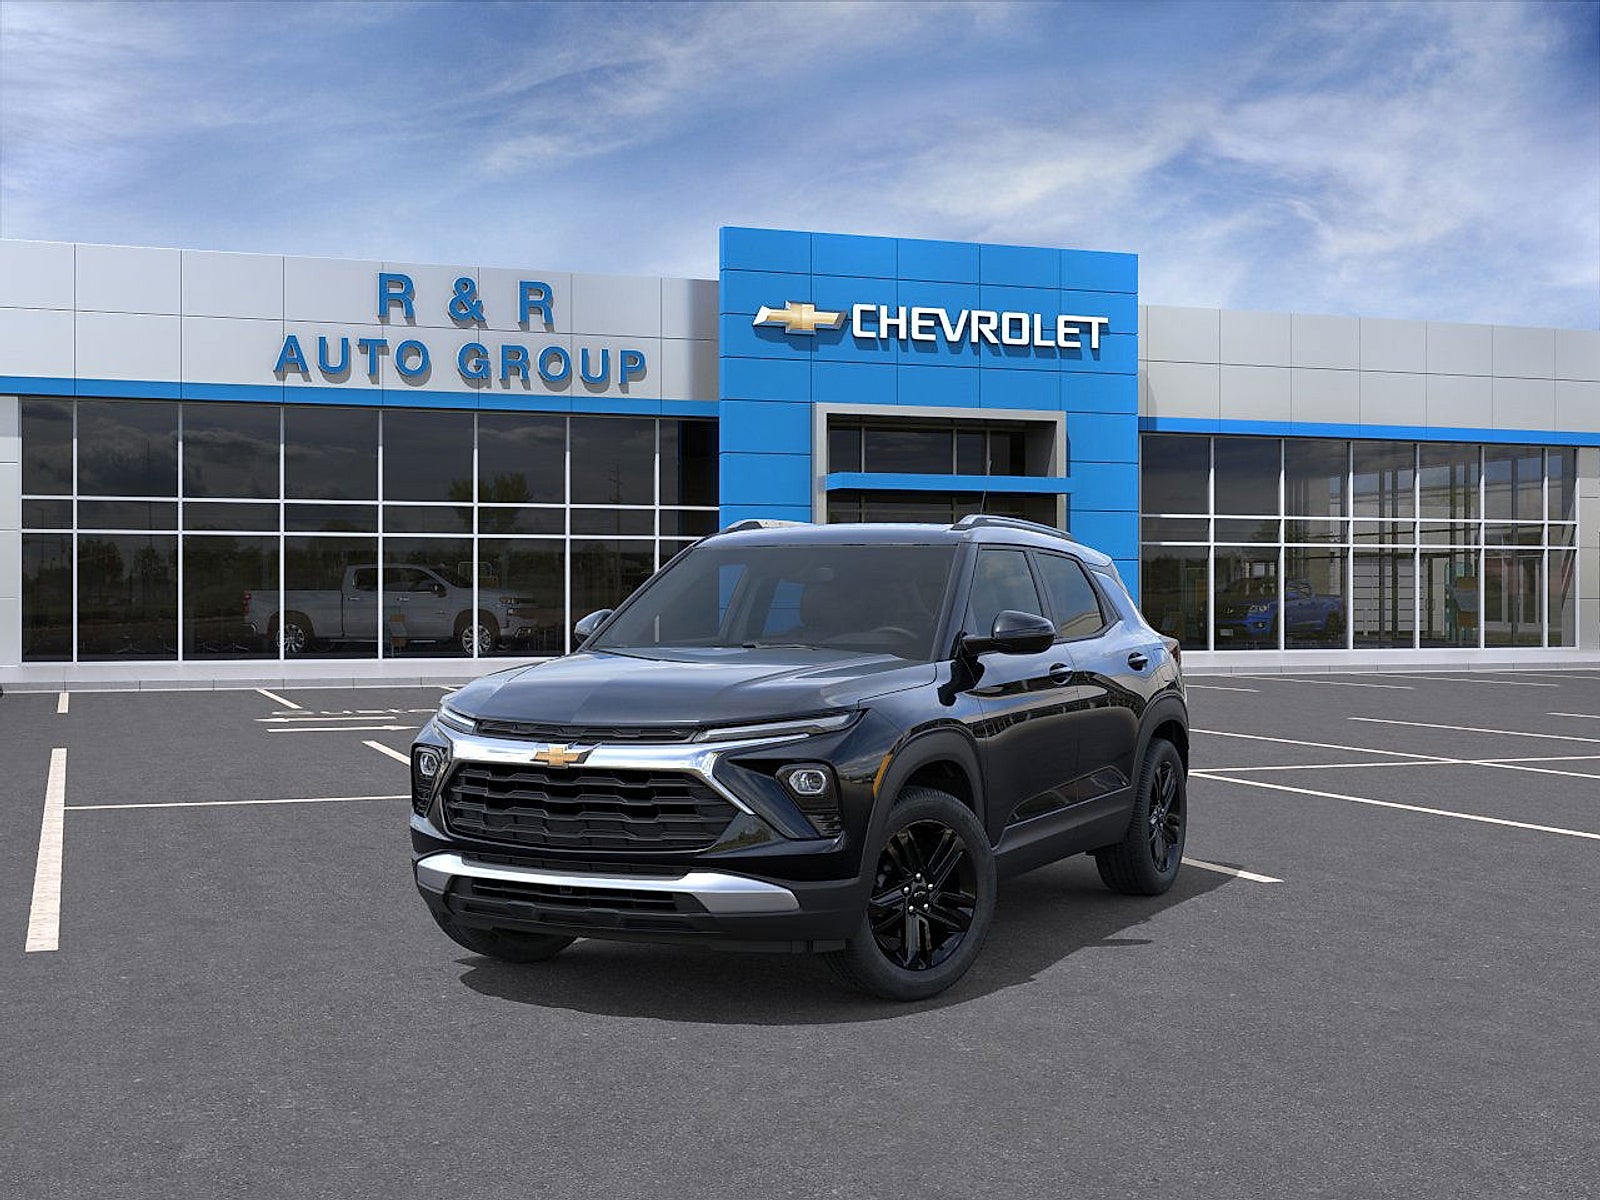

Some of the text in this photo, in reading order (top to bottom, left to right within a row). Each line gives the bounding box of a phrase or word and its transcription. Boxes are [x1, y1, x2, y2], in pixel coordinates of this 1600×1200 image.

[378, 272, 555, 325] R & R
[852, 303, 1109, 348] CHEVROLET
[274, 335, 647, 385] AUTO GROUP
